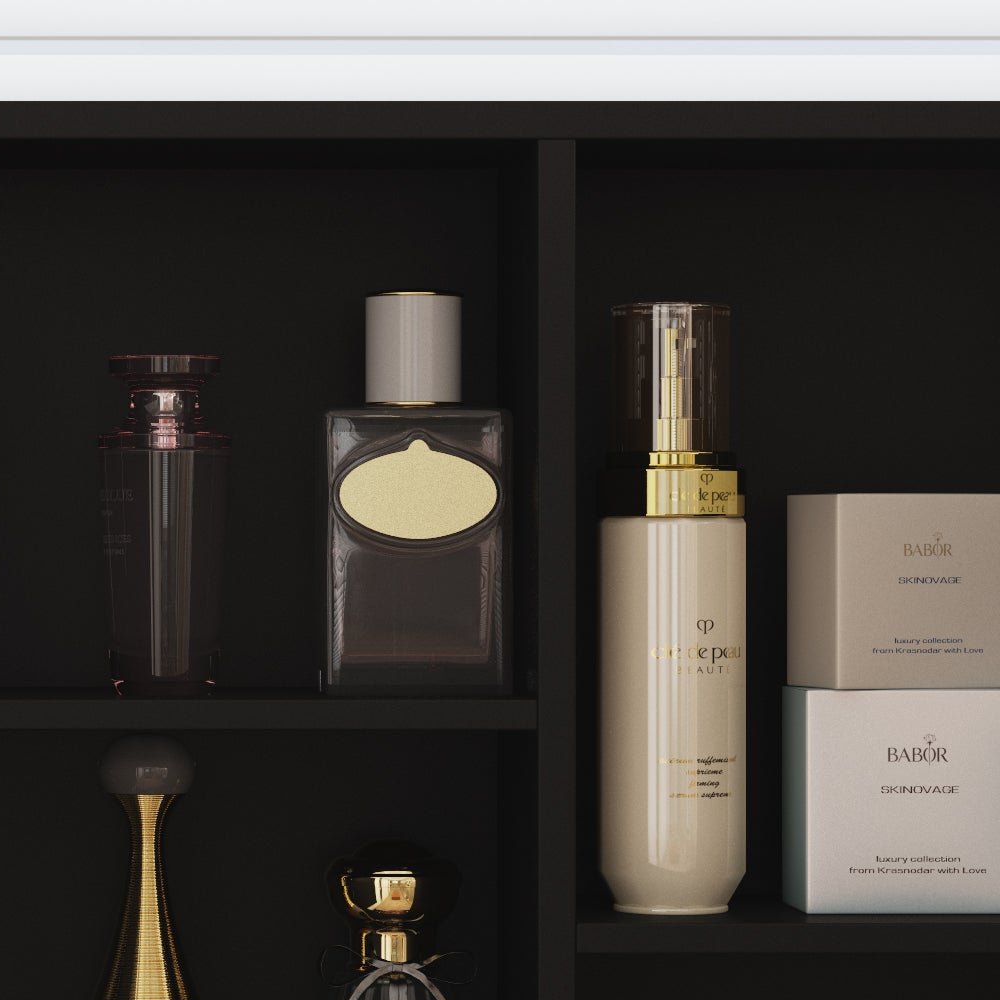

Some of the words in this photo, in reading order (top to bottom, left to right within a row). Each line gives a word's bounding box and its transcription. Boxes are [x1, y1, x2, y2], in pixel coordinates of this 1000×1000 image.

[903, 543, 953, 558] BABOR
[898, 576, 962, 585] SKINOVAGE
[894, 637, 921, 645] luxury
[872, 647, 894, 655] from
[895, 647, 942, 655] Krasnodar
[887, 747, 949, 763] BABOR
[880, 785, 960, 794] SKINOVAGE
[876, 855, 908, 864] luxury
[910, 855, 961, 863] collection
[849, 866, 875, 874] from
[877, 866, 935, 874] Krasnodar
[937, 866, 960, 874] with
